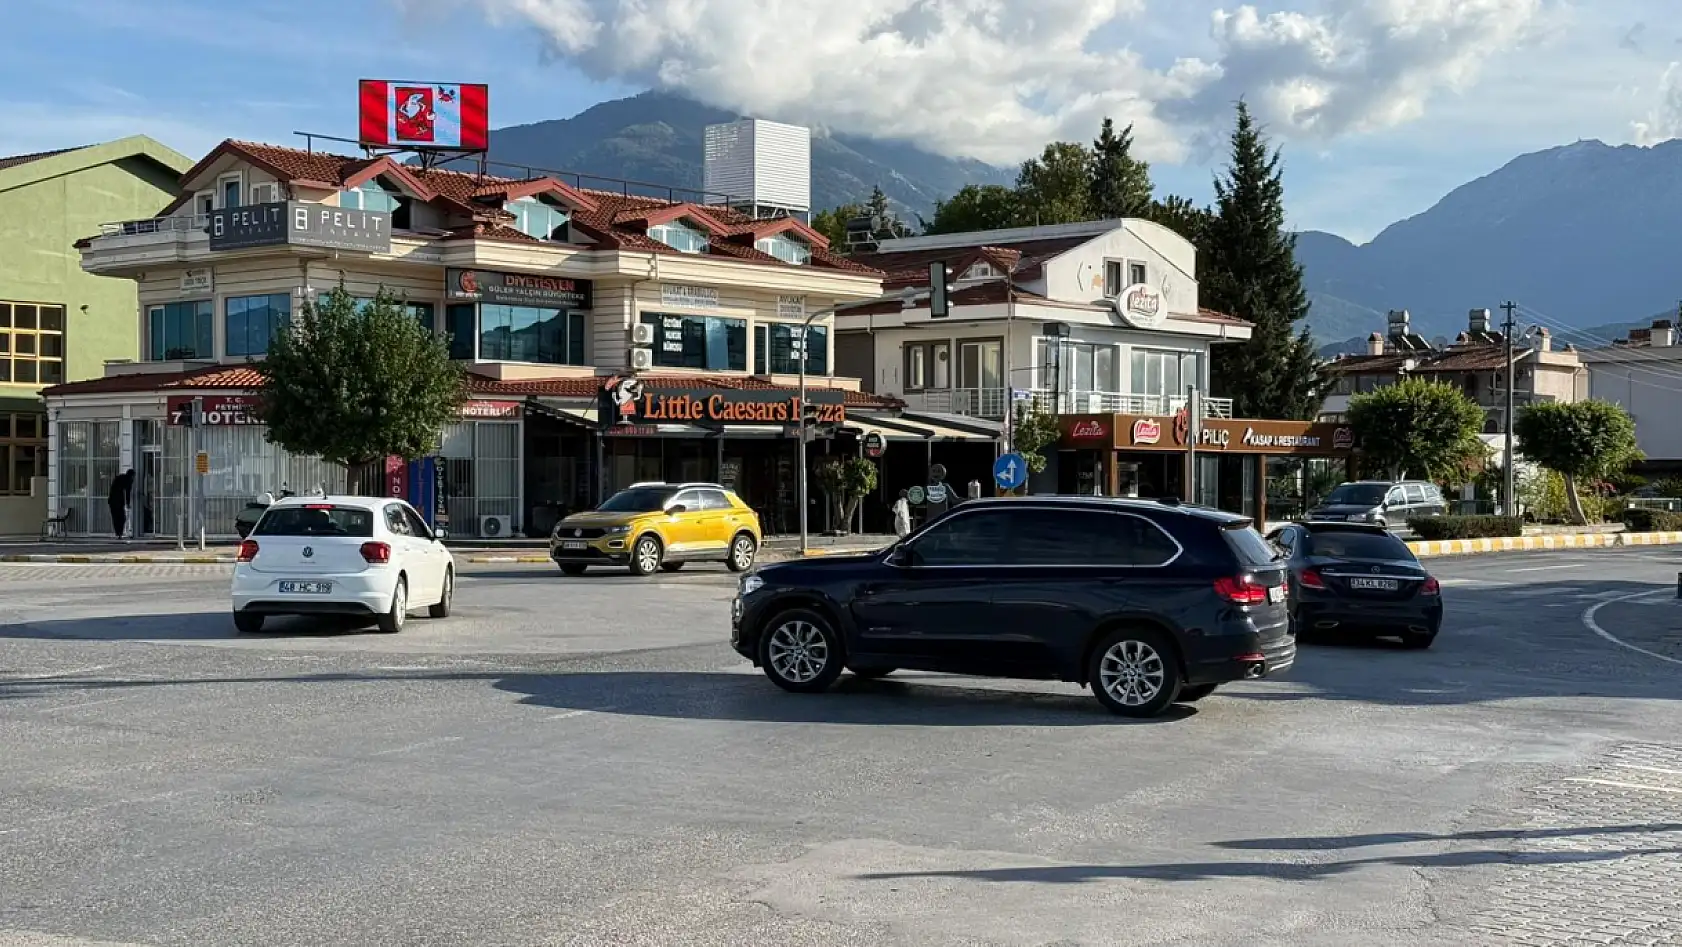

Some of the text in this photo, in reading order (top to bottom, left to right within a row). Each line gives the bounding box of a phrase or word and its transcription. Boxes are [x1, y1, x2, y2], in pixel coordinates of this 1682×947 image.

[321, 210, 383, 231] PELİT
[643, 393, 845, 422] Little Caesars Pzza
